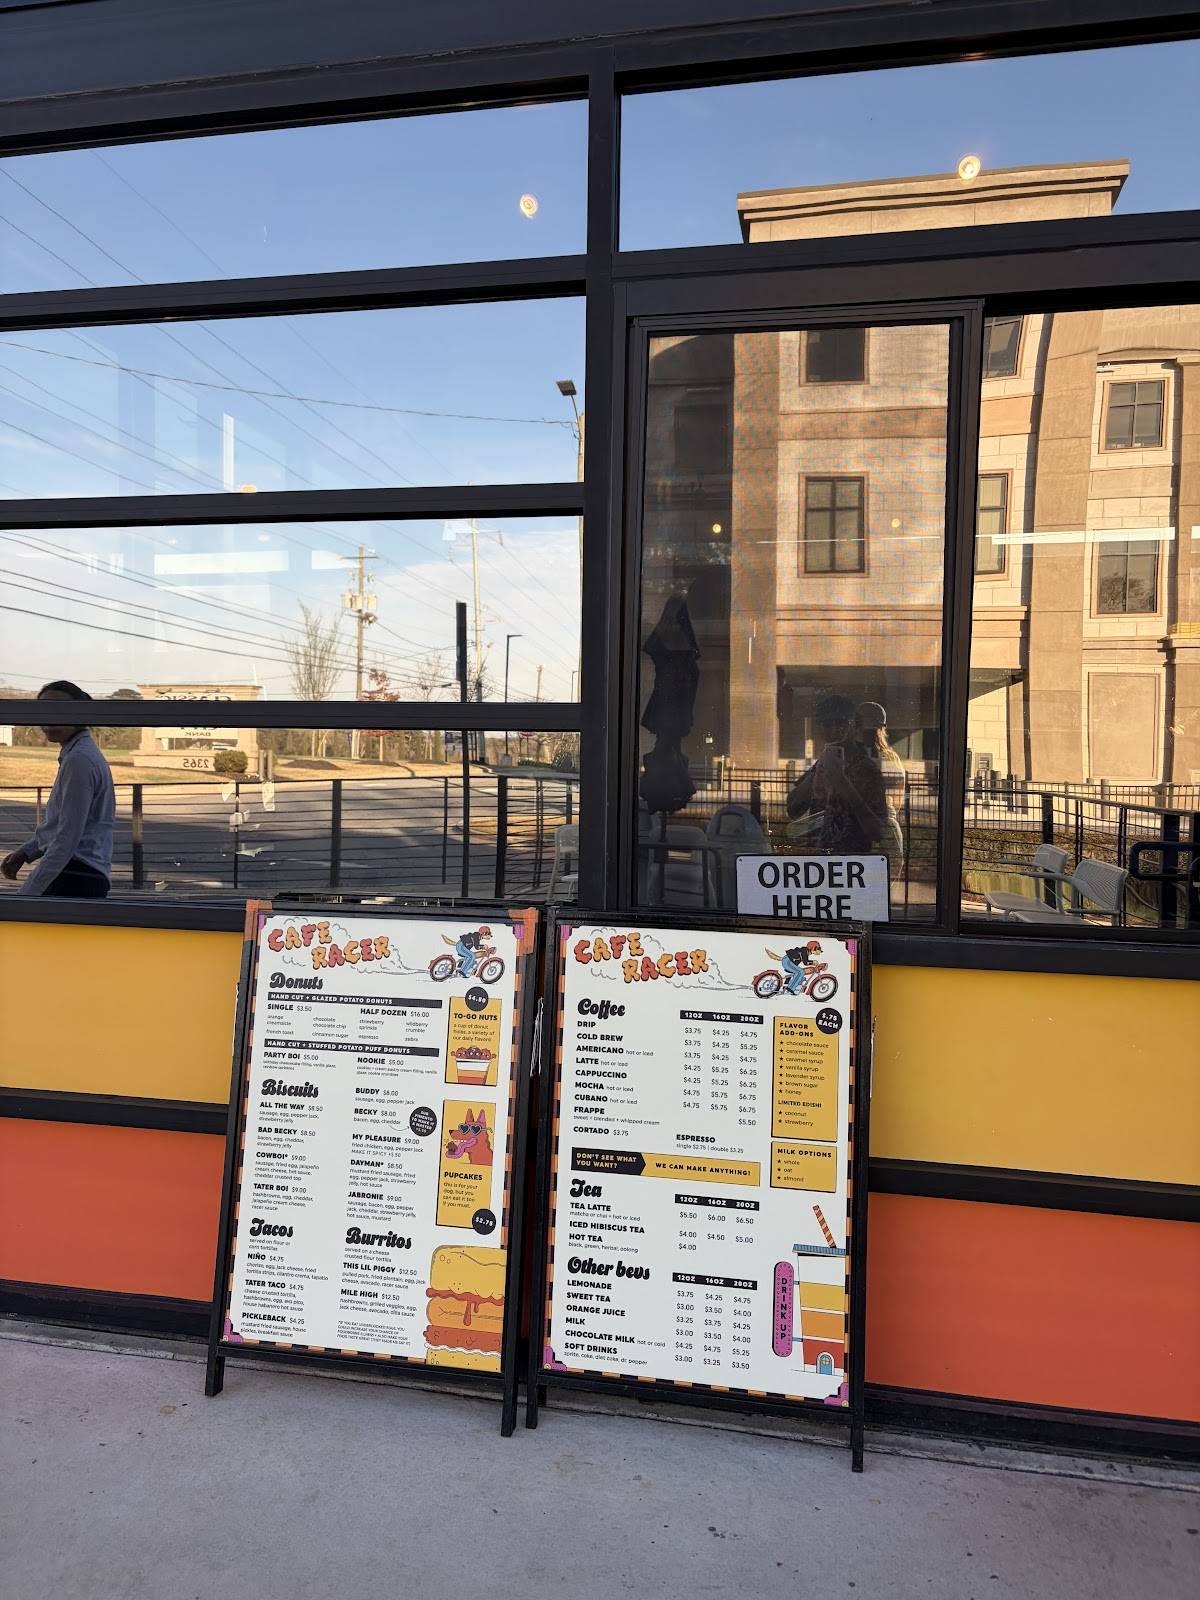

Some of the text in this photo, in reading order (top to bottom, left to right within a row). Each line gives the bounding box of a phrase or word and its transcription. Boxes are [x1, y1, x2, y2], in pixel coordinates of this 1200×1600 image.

[758, 861, 866, 888] ORDER
[772, 895, 853, 920] HERE
[267, 920, 333, 953] CAFE
[310, 935, 391, 970] RACER
[573, 931, 645, 964] CAFE
[621, 948, 709, 984] RACER
[269, 972, 323, 990] Donuts
[267, 1003, 294, 1011] SINGLE
[577, 998, 625, 1020] Coffee
[410, 1010, 430, 1018] $16.00
[454, 1012, 477, 1020] TO-GO
[577, 1020, 596, 1028] DRIP
[817, 1019, 838, 1029] EACH
[600, 1034, 623, 1042] BREW
[712, 1028, 730, 1036] $4.25
[740, 1030, 758, 1038] $4.75
[576, 1045, 624, 1054] AMERICANO
[684, 1039, 701, 1047] $3.75
[740, 1043, 758, 1051] $5.25
[263, 1051, 286, 1059] PARTY
[383, 1047, 411, 1055] DONUTS
[576, 1057, 599, 1065] LATTE
[575, 1069, 627, 1079] CAPPUCCINO
[261, 1078, 319, 1098] Biscuits
[355, 1087, 380, 1095] BUDDY
[575, 1082, 604, 1090] MOCHA
[574, 1094, 608, 1102] CUBANO
[711, 1091, 728, 1099] $5.75
[739, 1093, 756, 1101] $6.75
[574, 1106, 605, 1115] FRAPPE
[738, 1118, 756, 1126] $5.50
[274, 1127, 298, 1135] BECKY
[573, 1126, 629, 1137] CORTADO $3.75
[365, 1134, 401, 1143] PLEASURE
[676, 1134, 716, 1143] ESPRESSO
[576, 1152, 599, 1160] DON'T
[798, 1150, 832, 1158] OPTIONS
[444, 1171, 483, 1181] PUPCAKES
[709, 1167, 750, 1176] ANYTHING!
[569, 1178, 602, 1198] Tea
[348, 1191, 384, 1200] JABRONIE
[570, 1202, 611, 1212] TEA LATTE
[680, 1211, 754, 1224] $5.50 $6.00 $6.50
[249, 1217, 293, 1238] Tacos
[569, 1220, 645, 1234] ICED HIBISCUS TEA
[345, 1226, 412, 1250] Burritos
[569, 1233, 603, 1242] HOT TEA
[679, 1230, 754, 1244] $4.00 $4.50 $5.00
[247, 1252, 266, 1260] NIÑO
[343, 1262, 359, 1270] THIS
[373, 1265, 396, 1273] PIGGY
[399, 1268, 418, 1276] $12.50
[567, 1256, 650, 1280] Other bevs
[245, 1279, 304, 1291] TATER TACO $4.75
[567, 1279, 612, 1290] LEMONADE
[340, 1288, 400, 1301] MILE HIGH $12.50
[566, 1292, 611, 1303] SWEET TEA
[677, 1290, 751, 1304] $3.75 $4.25 $4.75
[566, 1304, 626, 1317] ORANGE JUICE
[779, 1276, 788, 1341] DRINK UP
[242, 1312, 305, 1325] PICKLEBACK $4.25
[565, 1317, 586, 1325] MILK
[565, 1329, 635, 1344] CHOCOLATE MILK
[564, 1342, 618, 1354] SOFT DRINKS
[675, 1354, 750, 1370] $3.00 $3.25 $3.50
